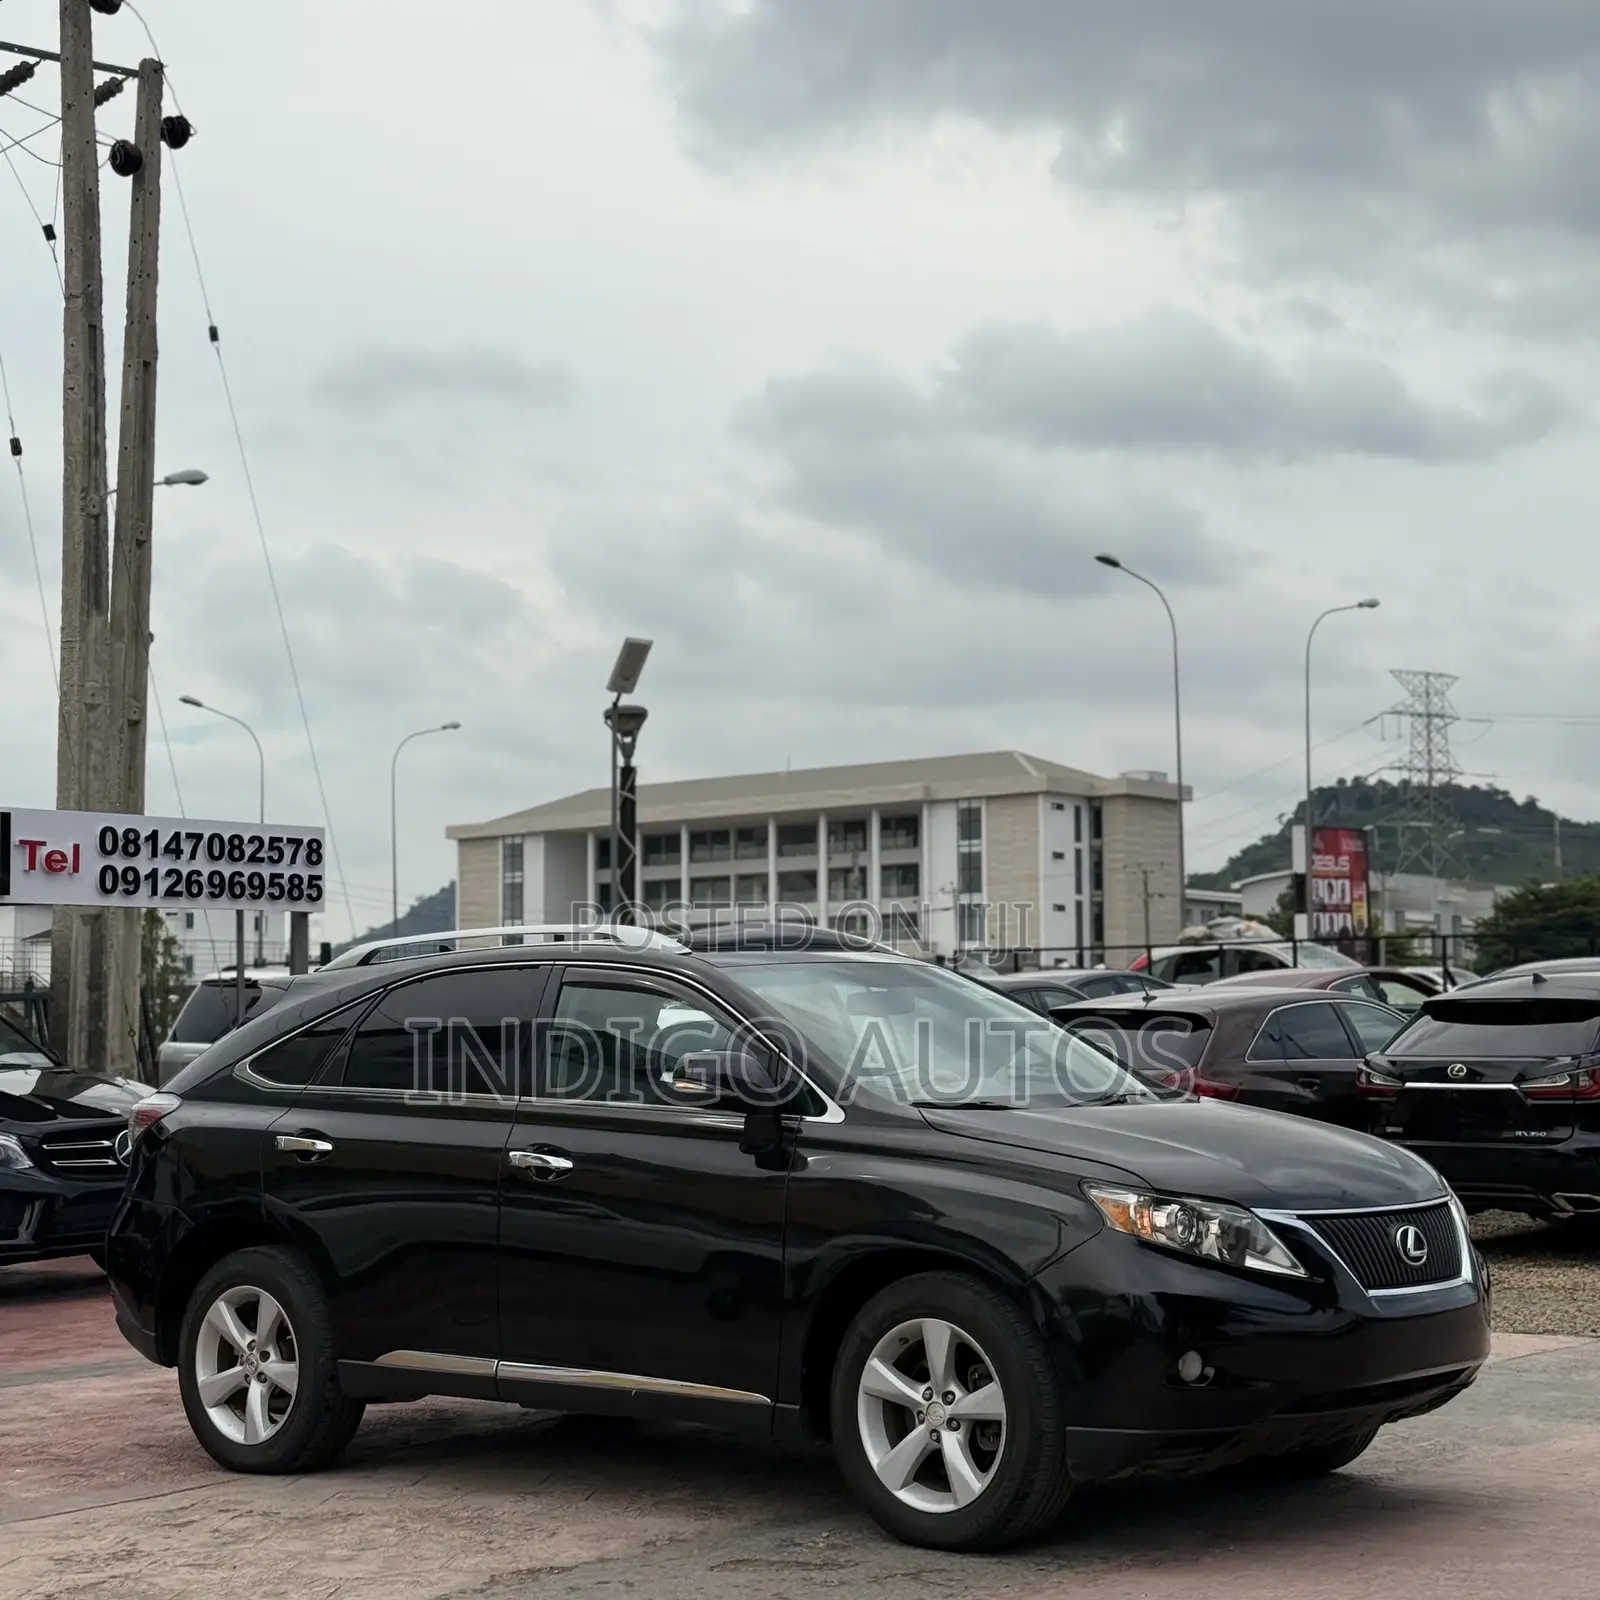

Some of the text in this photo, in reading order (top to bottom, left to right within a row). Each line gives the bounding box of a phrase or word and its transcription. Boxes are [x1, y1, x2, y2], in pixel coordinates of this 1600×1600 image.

[19, 839, 80, 873] Tel
[99, 826, 322, 865] 08147082578
[99, 865, 322, 901] 09126969585
